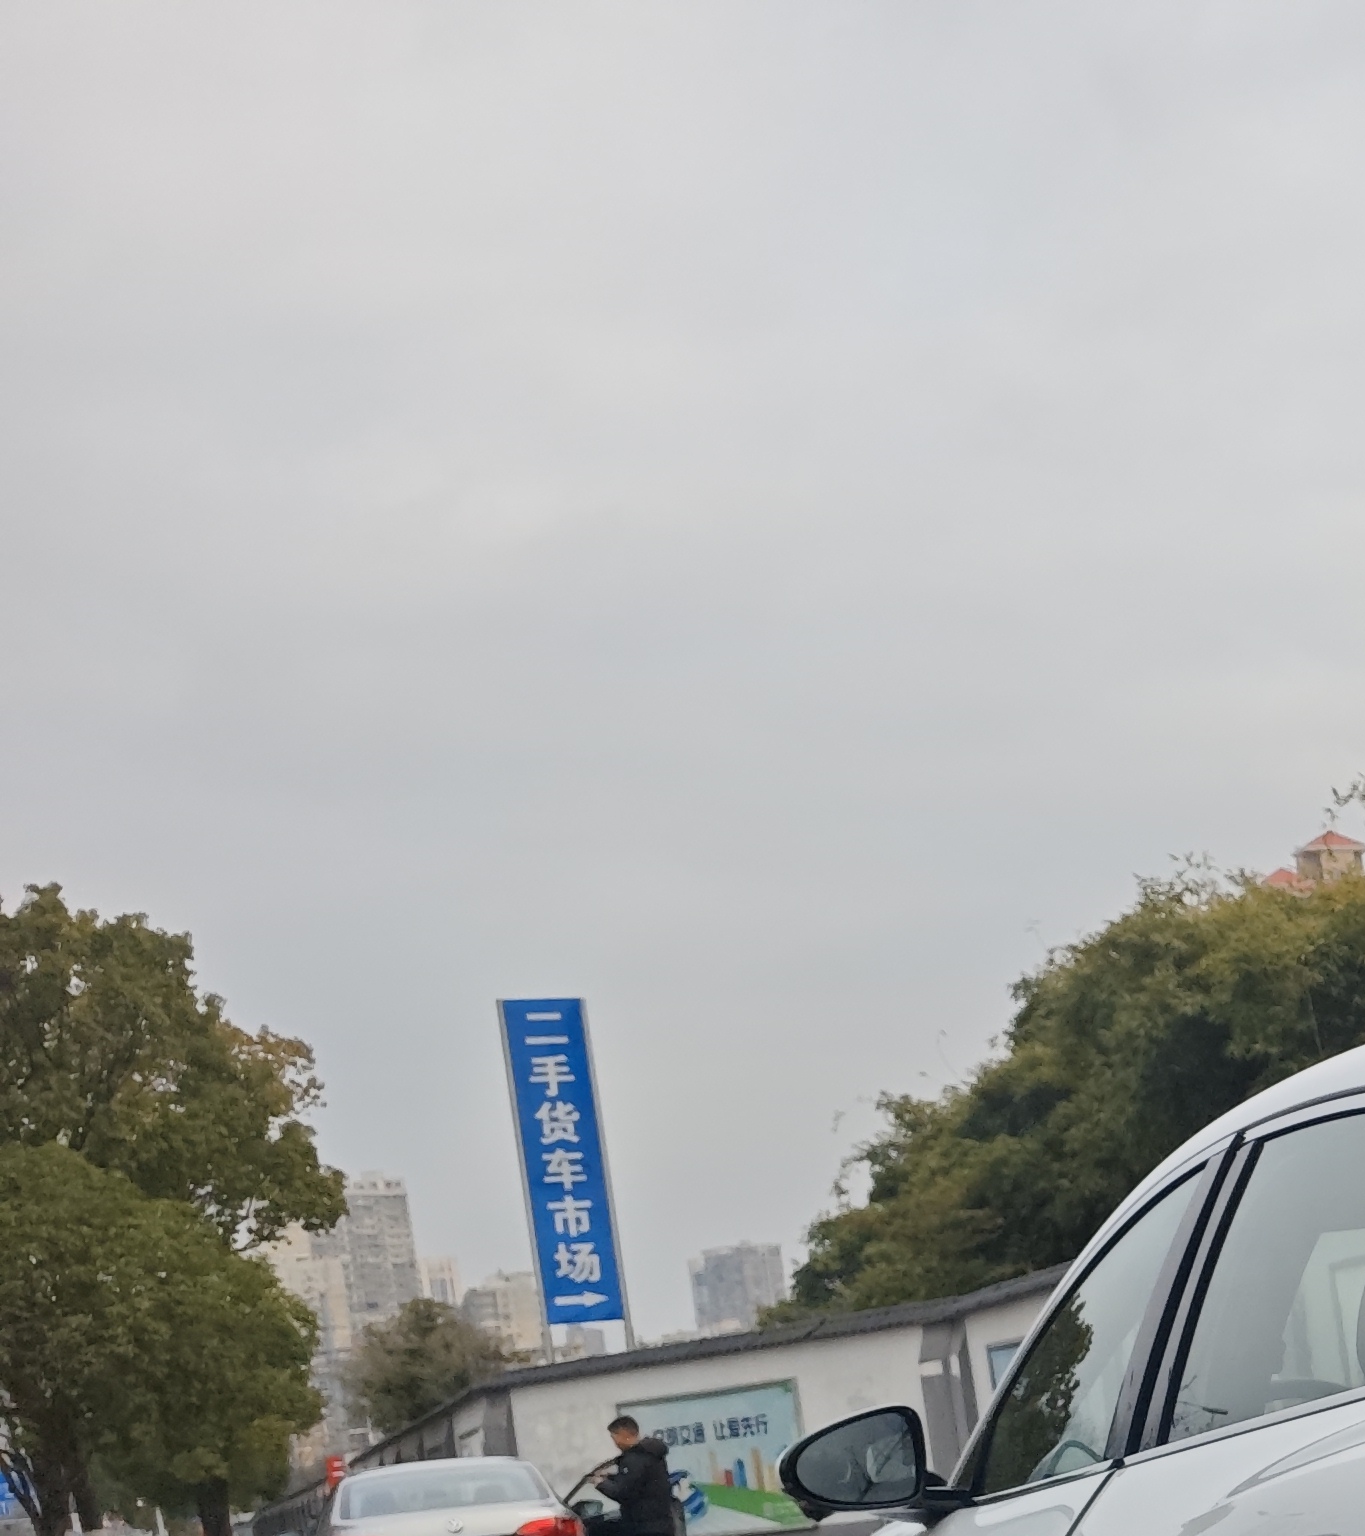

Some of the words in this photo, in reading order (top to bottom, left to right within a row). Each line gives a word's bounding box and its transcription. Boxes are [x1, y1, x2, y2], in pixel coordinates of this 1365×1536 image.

[524, 1011, 602, 1284] 二手货车市场
